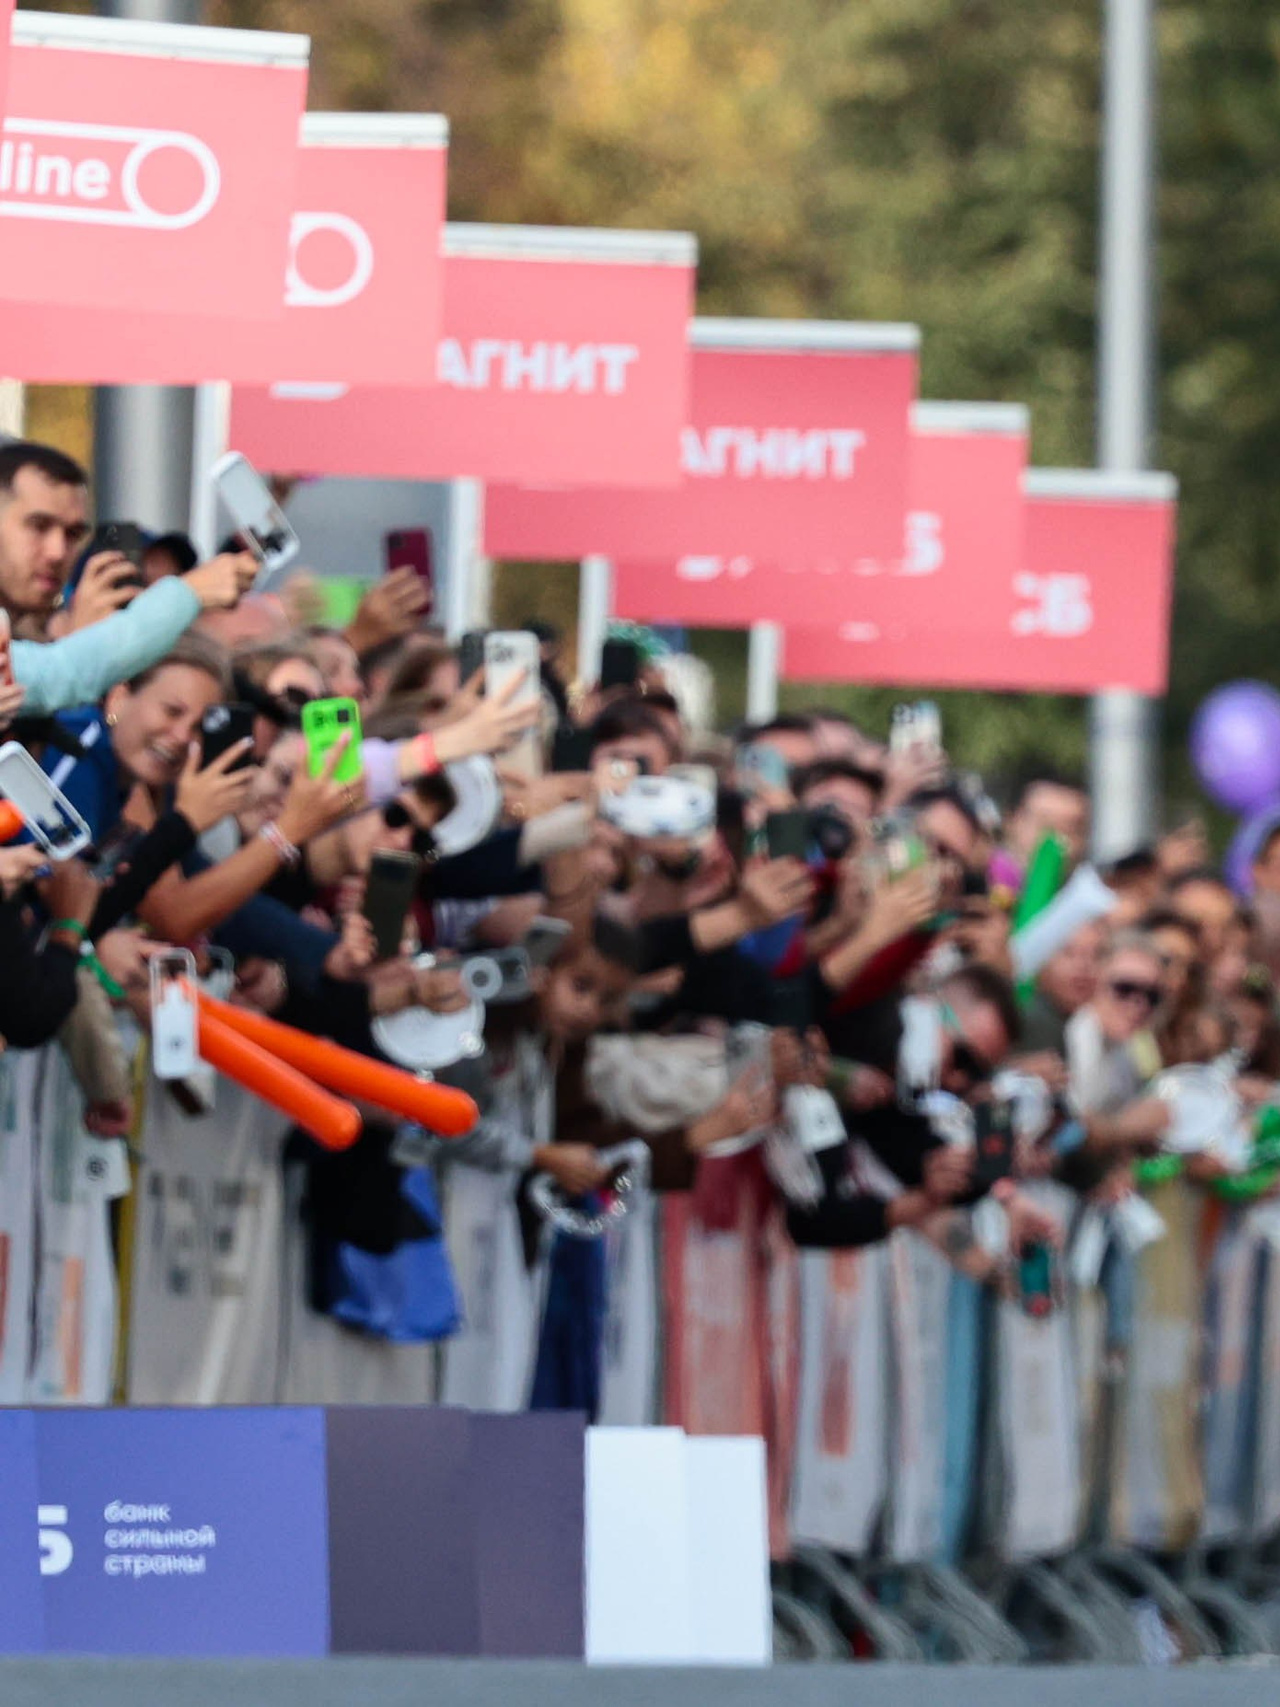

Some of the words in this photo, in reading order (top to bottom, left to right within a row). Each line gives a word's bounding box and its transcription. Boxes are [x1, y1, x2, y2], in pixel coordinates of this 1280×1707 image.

[104, 1500, 171, 1523] банк
[104, 1525, 216, 1548] сильной
[104, 1554, 206, 1578] страны
